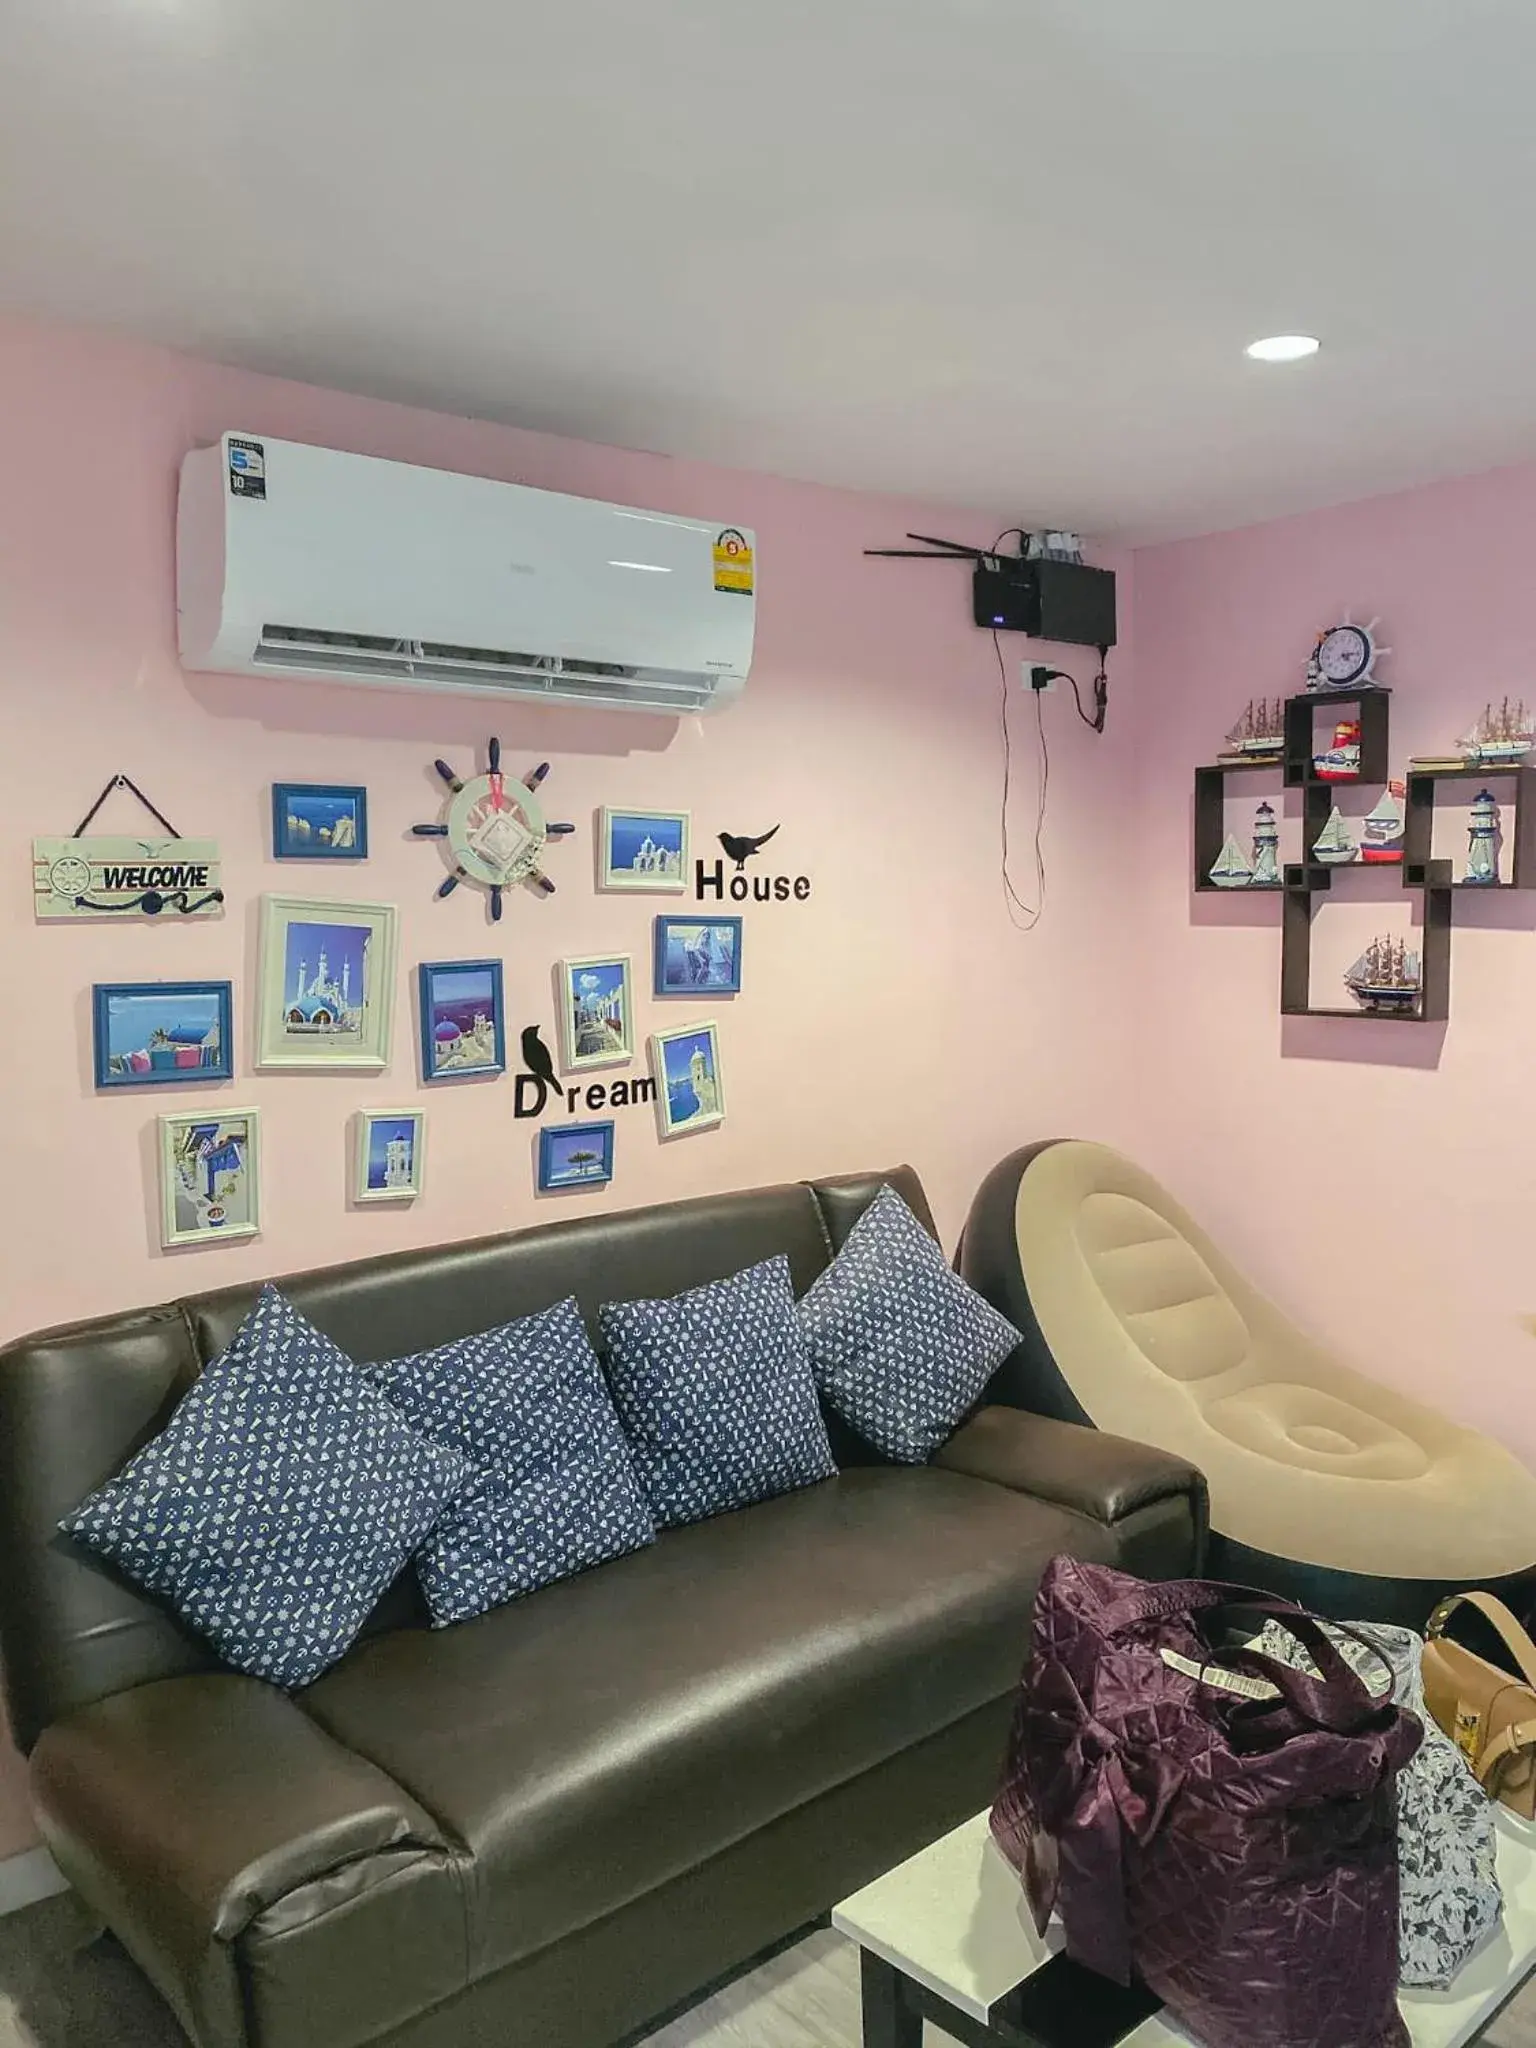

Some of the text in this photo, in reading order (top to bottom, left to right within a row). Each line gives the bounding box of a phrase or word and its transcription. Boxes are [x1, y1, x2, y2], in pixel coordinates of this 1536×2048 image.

[231, 449, 248, 469] 5
[103, 866, 208, 888] WELCOME
[696, 859, 810, 901] House
[514, 1073, 657, 1118] Dream
